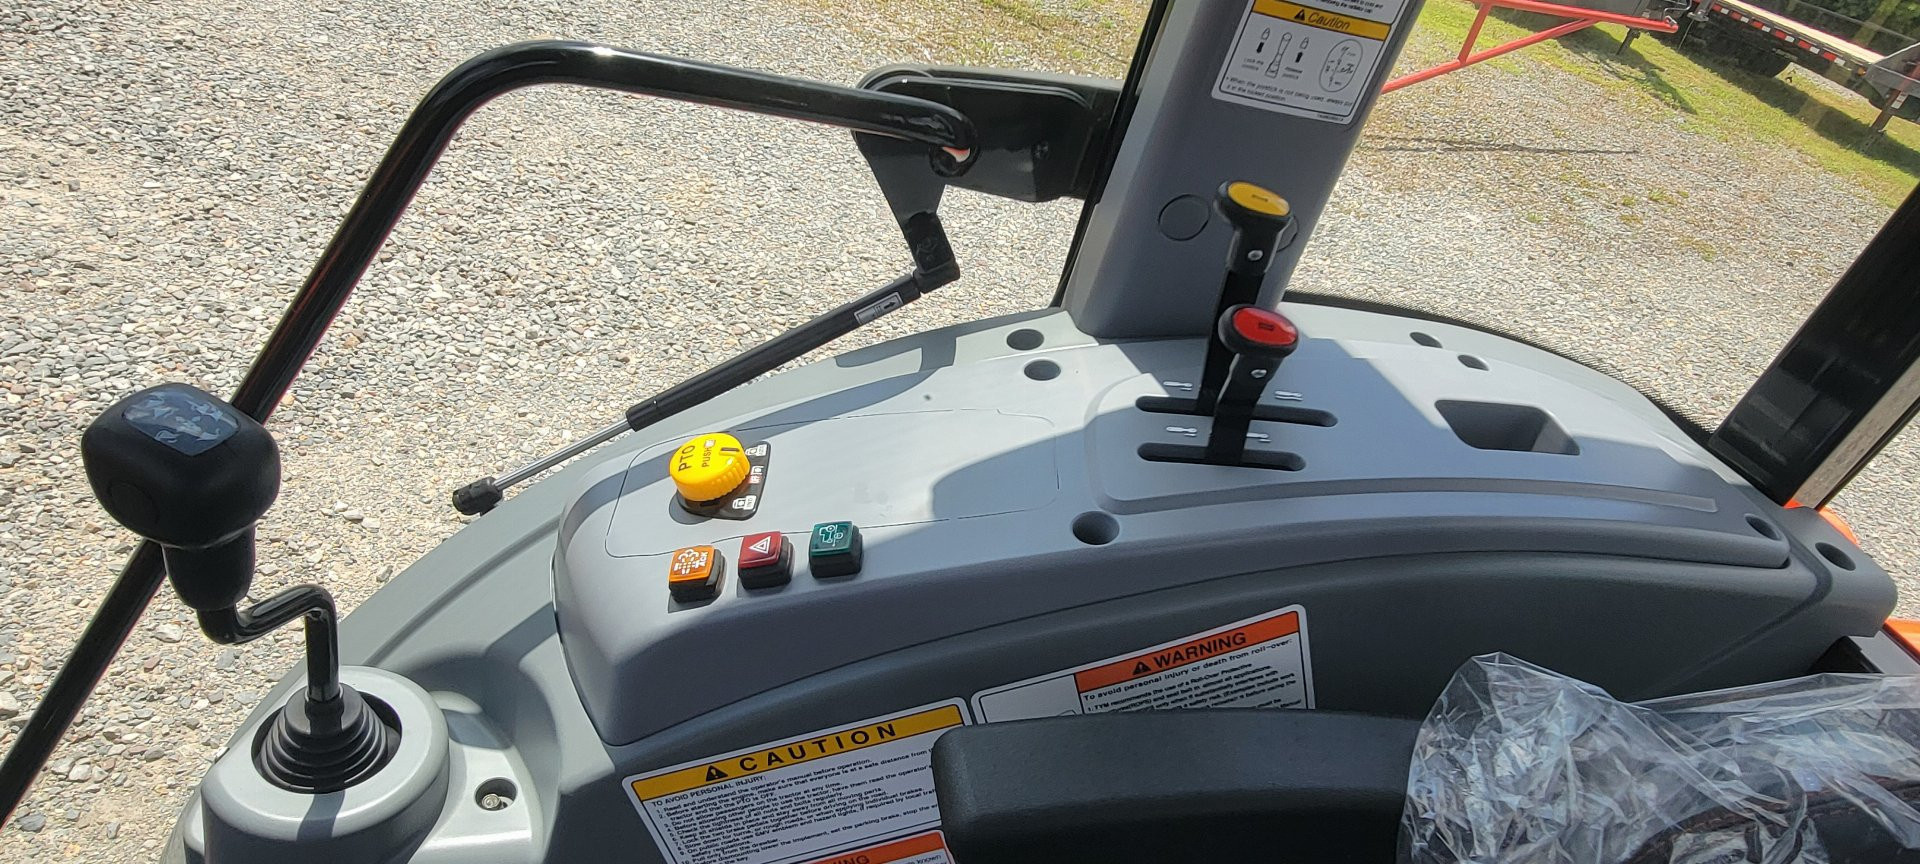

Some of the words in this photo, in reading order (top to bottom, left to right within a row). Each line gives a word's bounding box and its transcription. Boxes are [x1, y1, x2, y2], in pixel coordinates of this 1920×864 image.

[1308, 12, 1351, 31] Caution
[678, 445, 696, 472] PTO
[701, 447, 712, 468] PUSH
[1154, 632, 1247, 669] WARNING
[1097, 686, 1121, 697] avoid
[1123, 676, 1162, 691] personal
[1164, 669, 1189, 679] injury
[1202, 658, 1227, 668] death
[1229, 652, 1248, 660] from
[739, 723, 896, 772] CAUTION
[663, 804, 681, 812] Read
[697, 791, 736, 803] understand
[749, 778, 785, 791] operator's
[786, 772, 812, 781] manual
[812, 766, 835, 775] before
[836, 758, 871, 770] operation.
[664, 794, 688, 803] AVOID
[689, 782, 733, 797] PERSONAL
[734, 774, 766, 786] INJURY:
